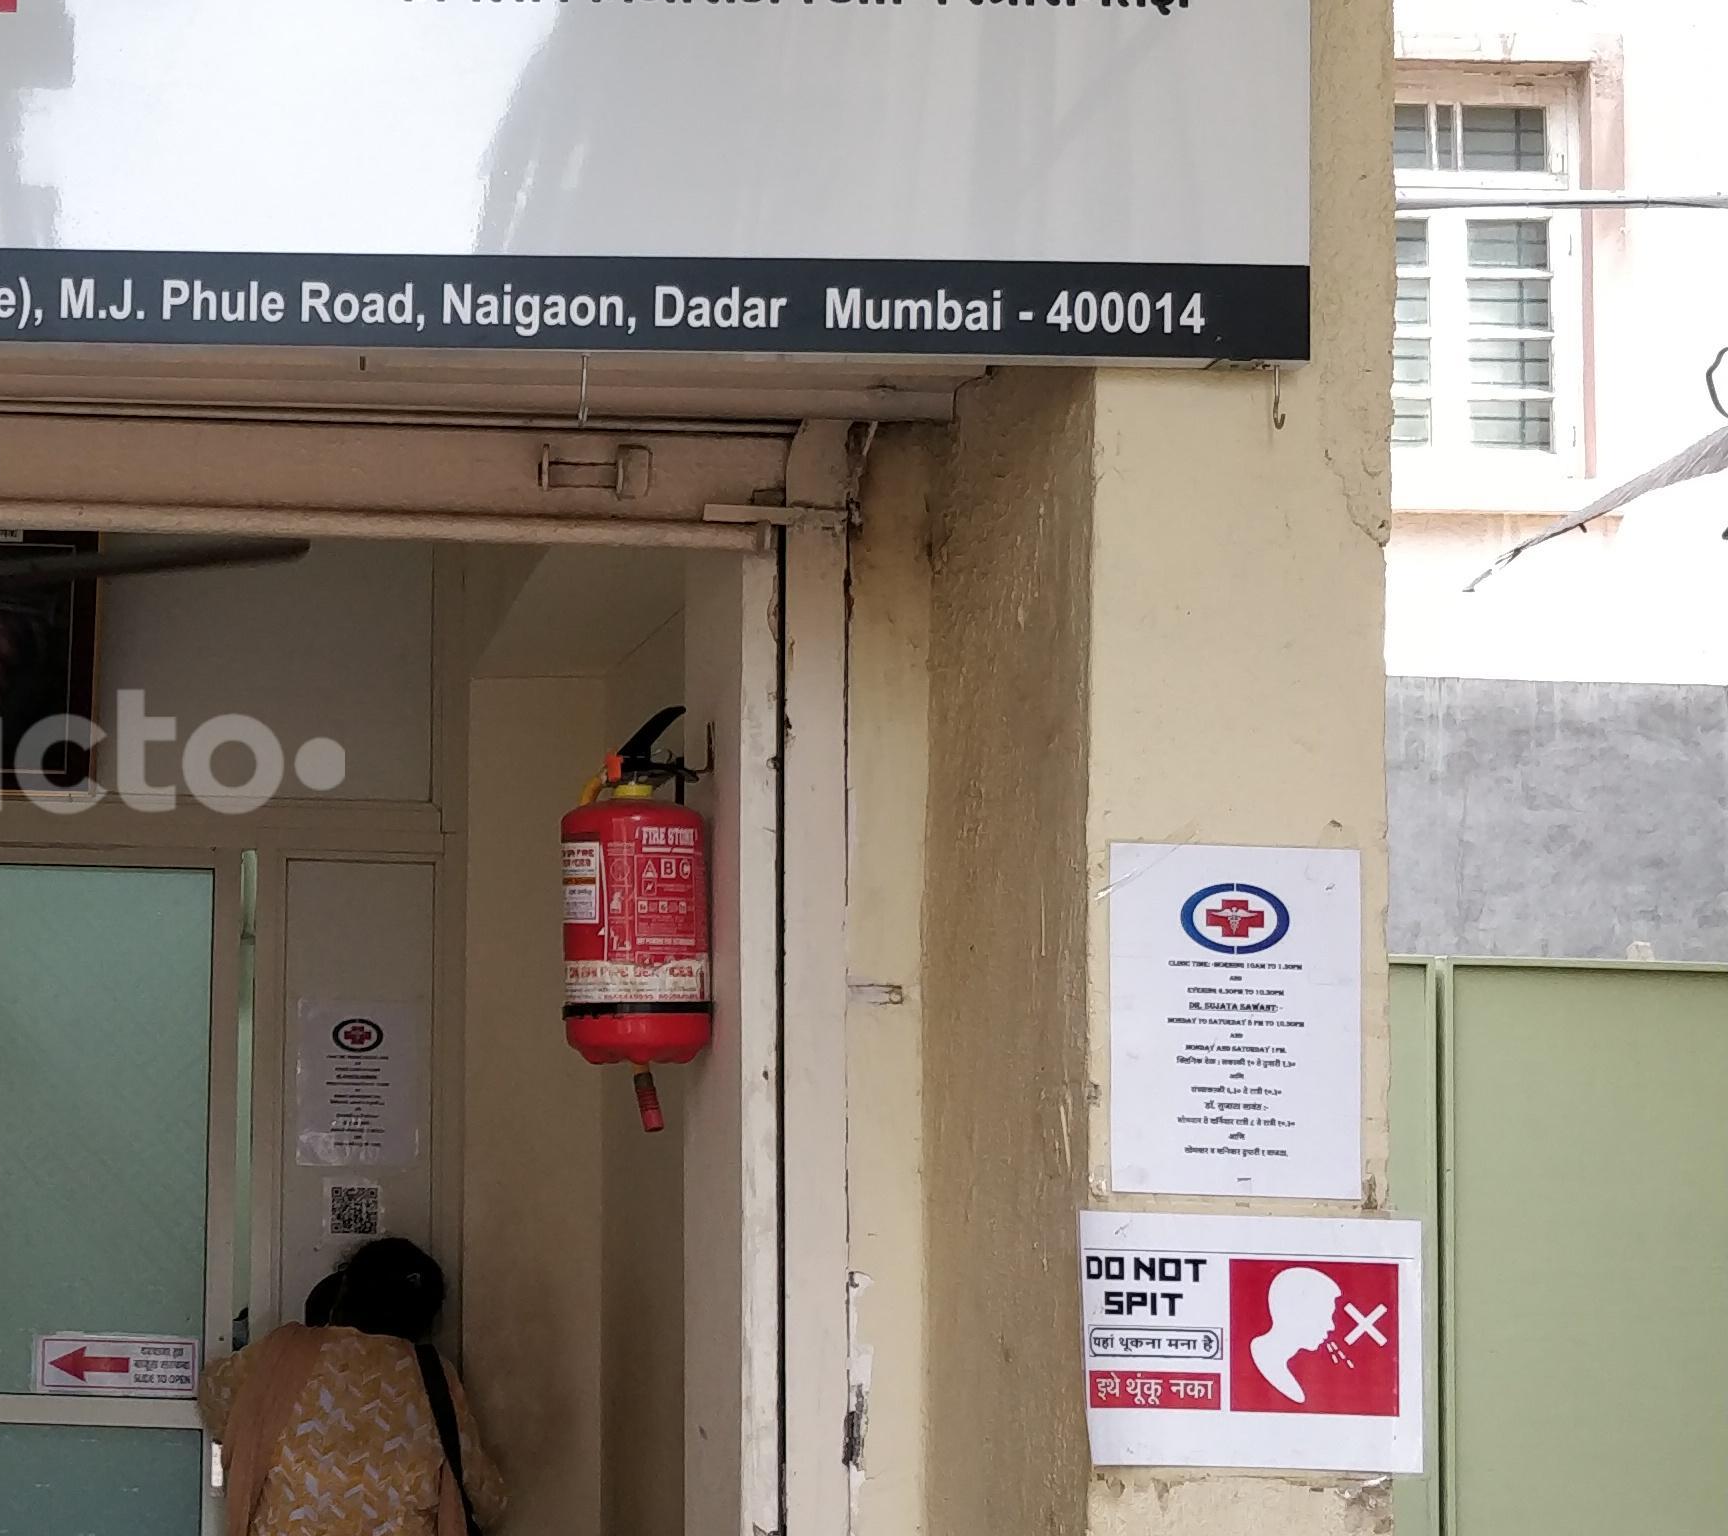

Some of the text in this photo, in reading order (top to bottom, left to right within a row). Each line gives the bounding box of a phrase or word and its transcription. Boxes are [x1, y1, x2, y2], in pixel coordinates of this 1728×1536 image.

[60, 277, 145, 320] M.J.
[162, 279, 285, 322] Phule
[301, 281, 425, 332] Road,
[442, 283, 636, 337] Naigaon,
[654, 285, 788, 329] Dadar
[825, 287, 1002, 331] Mumbai
[1046, 290, 1206, 334] 400014
[1204, 1002, 1238, 1010] SUJATA
[1085, 1255, 1207, 1283] DO NOT
[1104, 1290, 1184, 1317] SPIT
[1166, 1338, 1198, 1350] मना
[1169, 1380, 1214, 1399] नका
